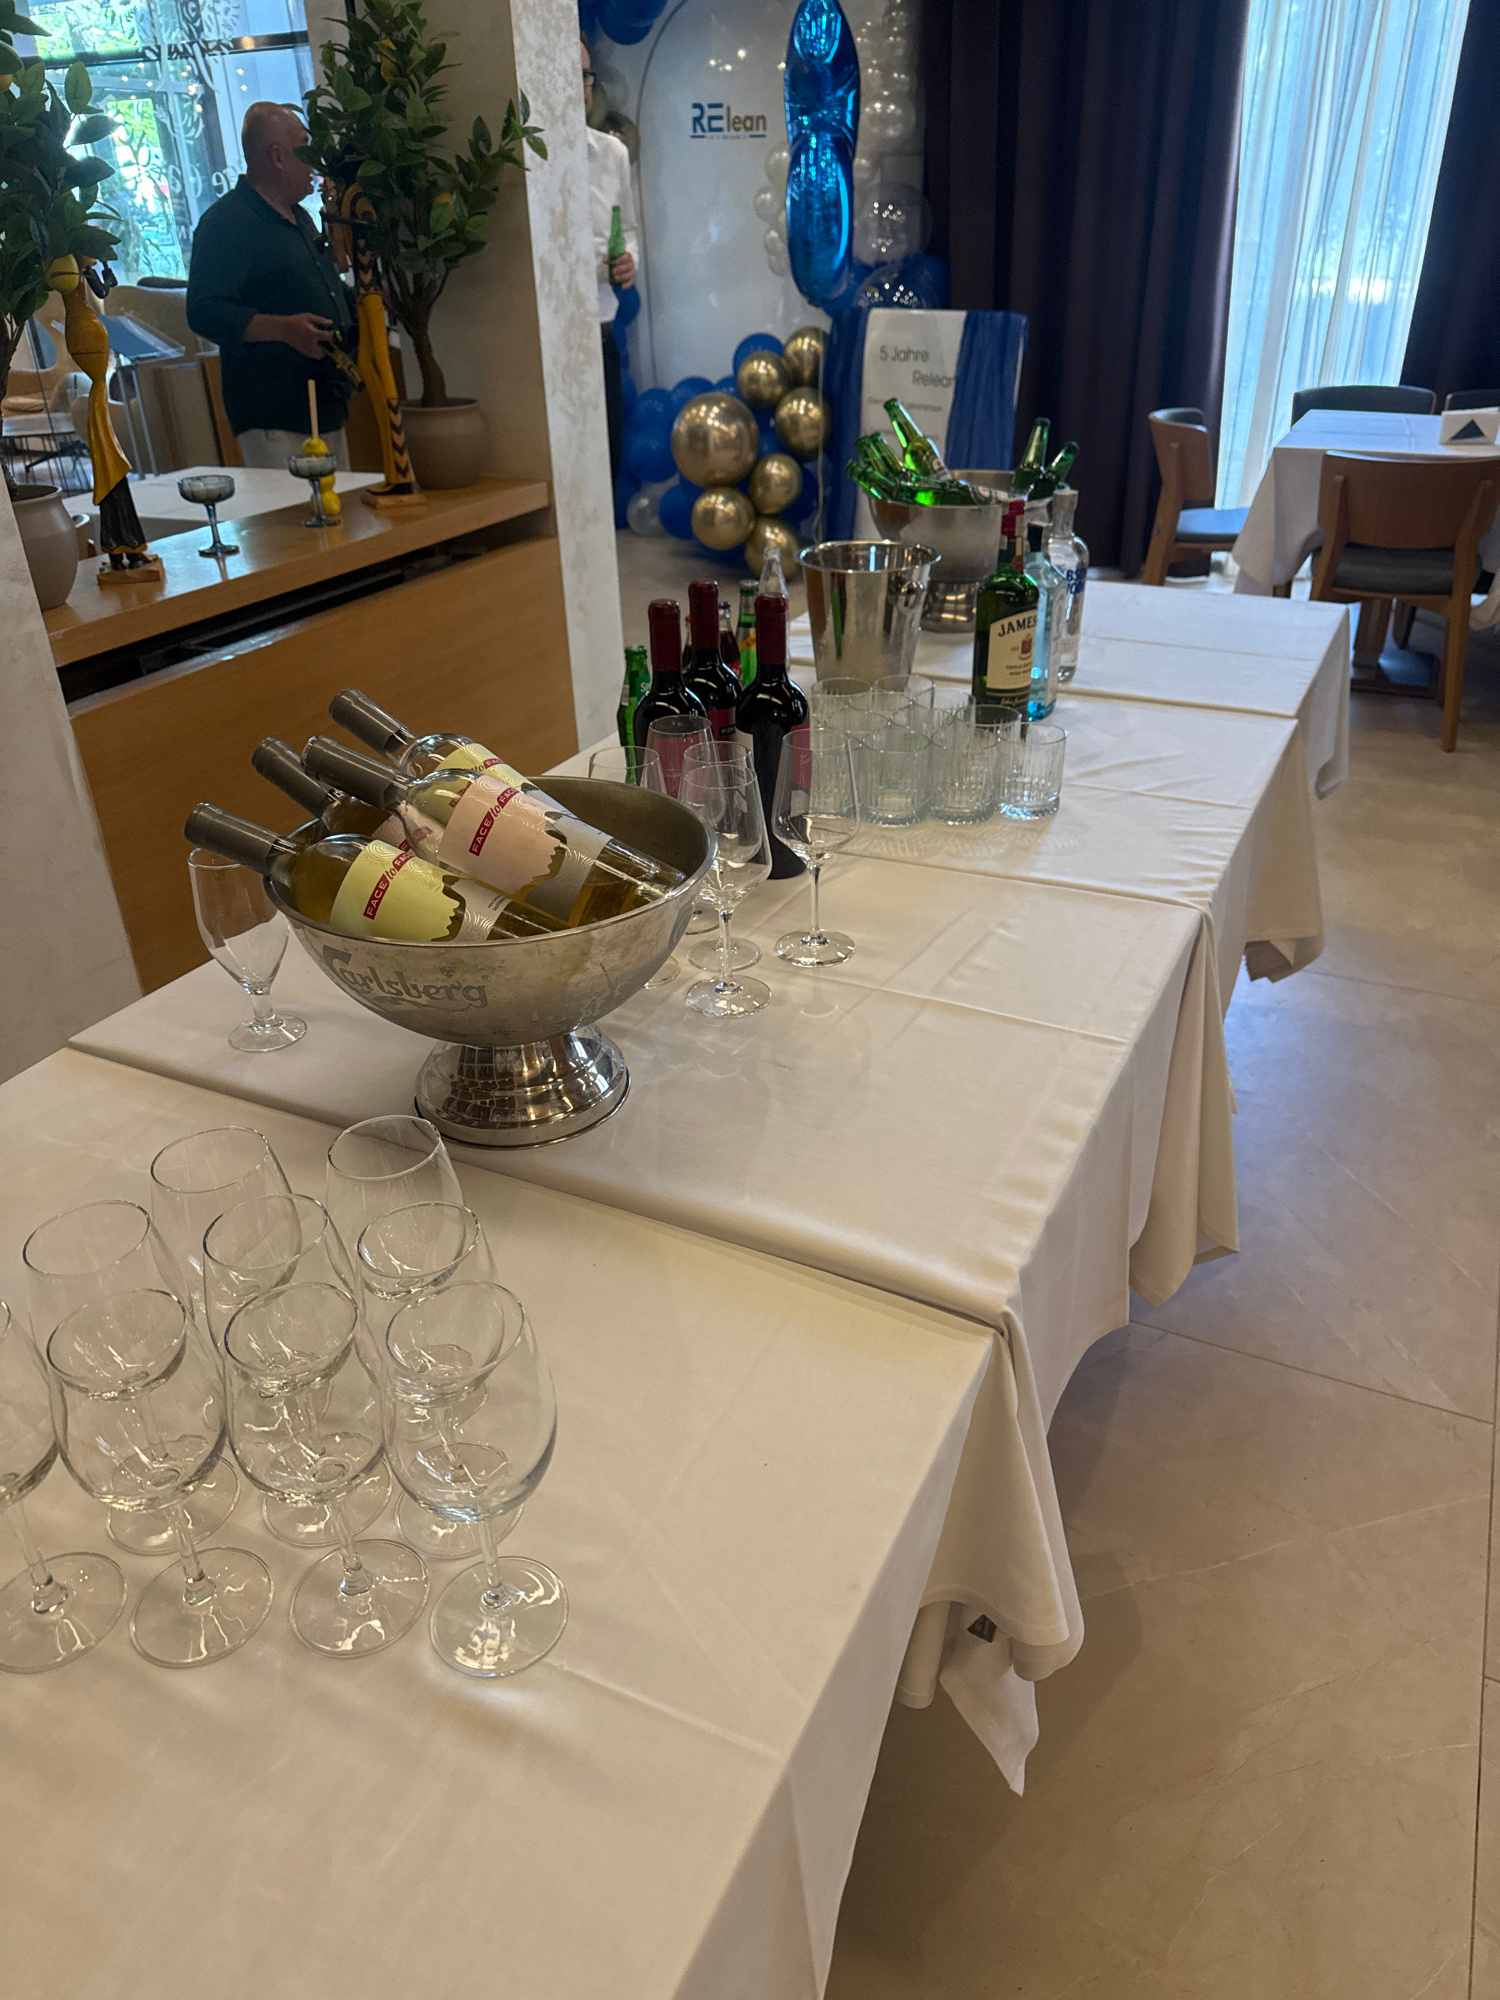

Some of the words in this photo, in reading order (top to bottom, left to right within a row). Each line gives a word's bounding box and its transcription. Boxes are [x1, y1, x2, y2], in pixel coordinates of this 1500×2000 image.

[891, 346, 929, 363] Jahre
[471, 817, 493, 854] FACE
[490, 803, 501, 818] to
[365, 879, 389, 917] FACE
[385, 866, 397, 881] to
[322, 944, 489, 1012] Carlsberg
